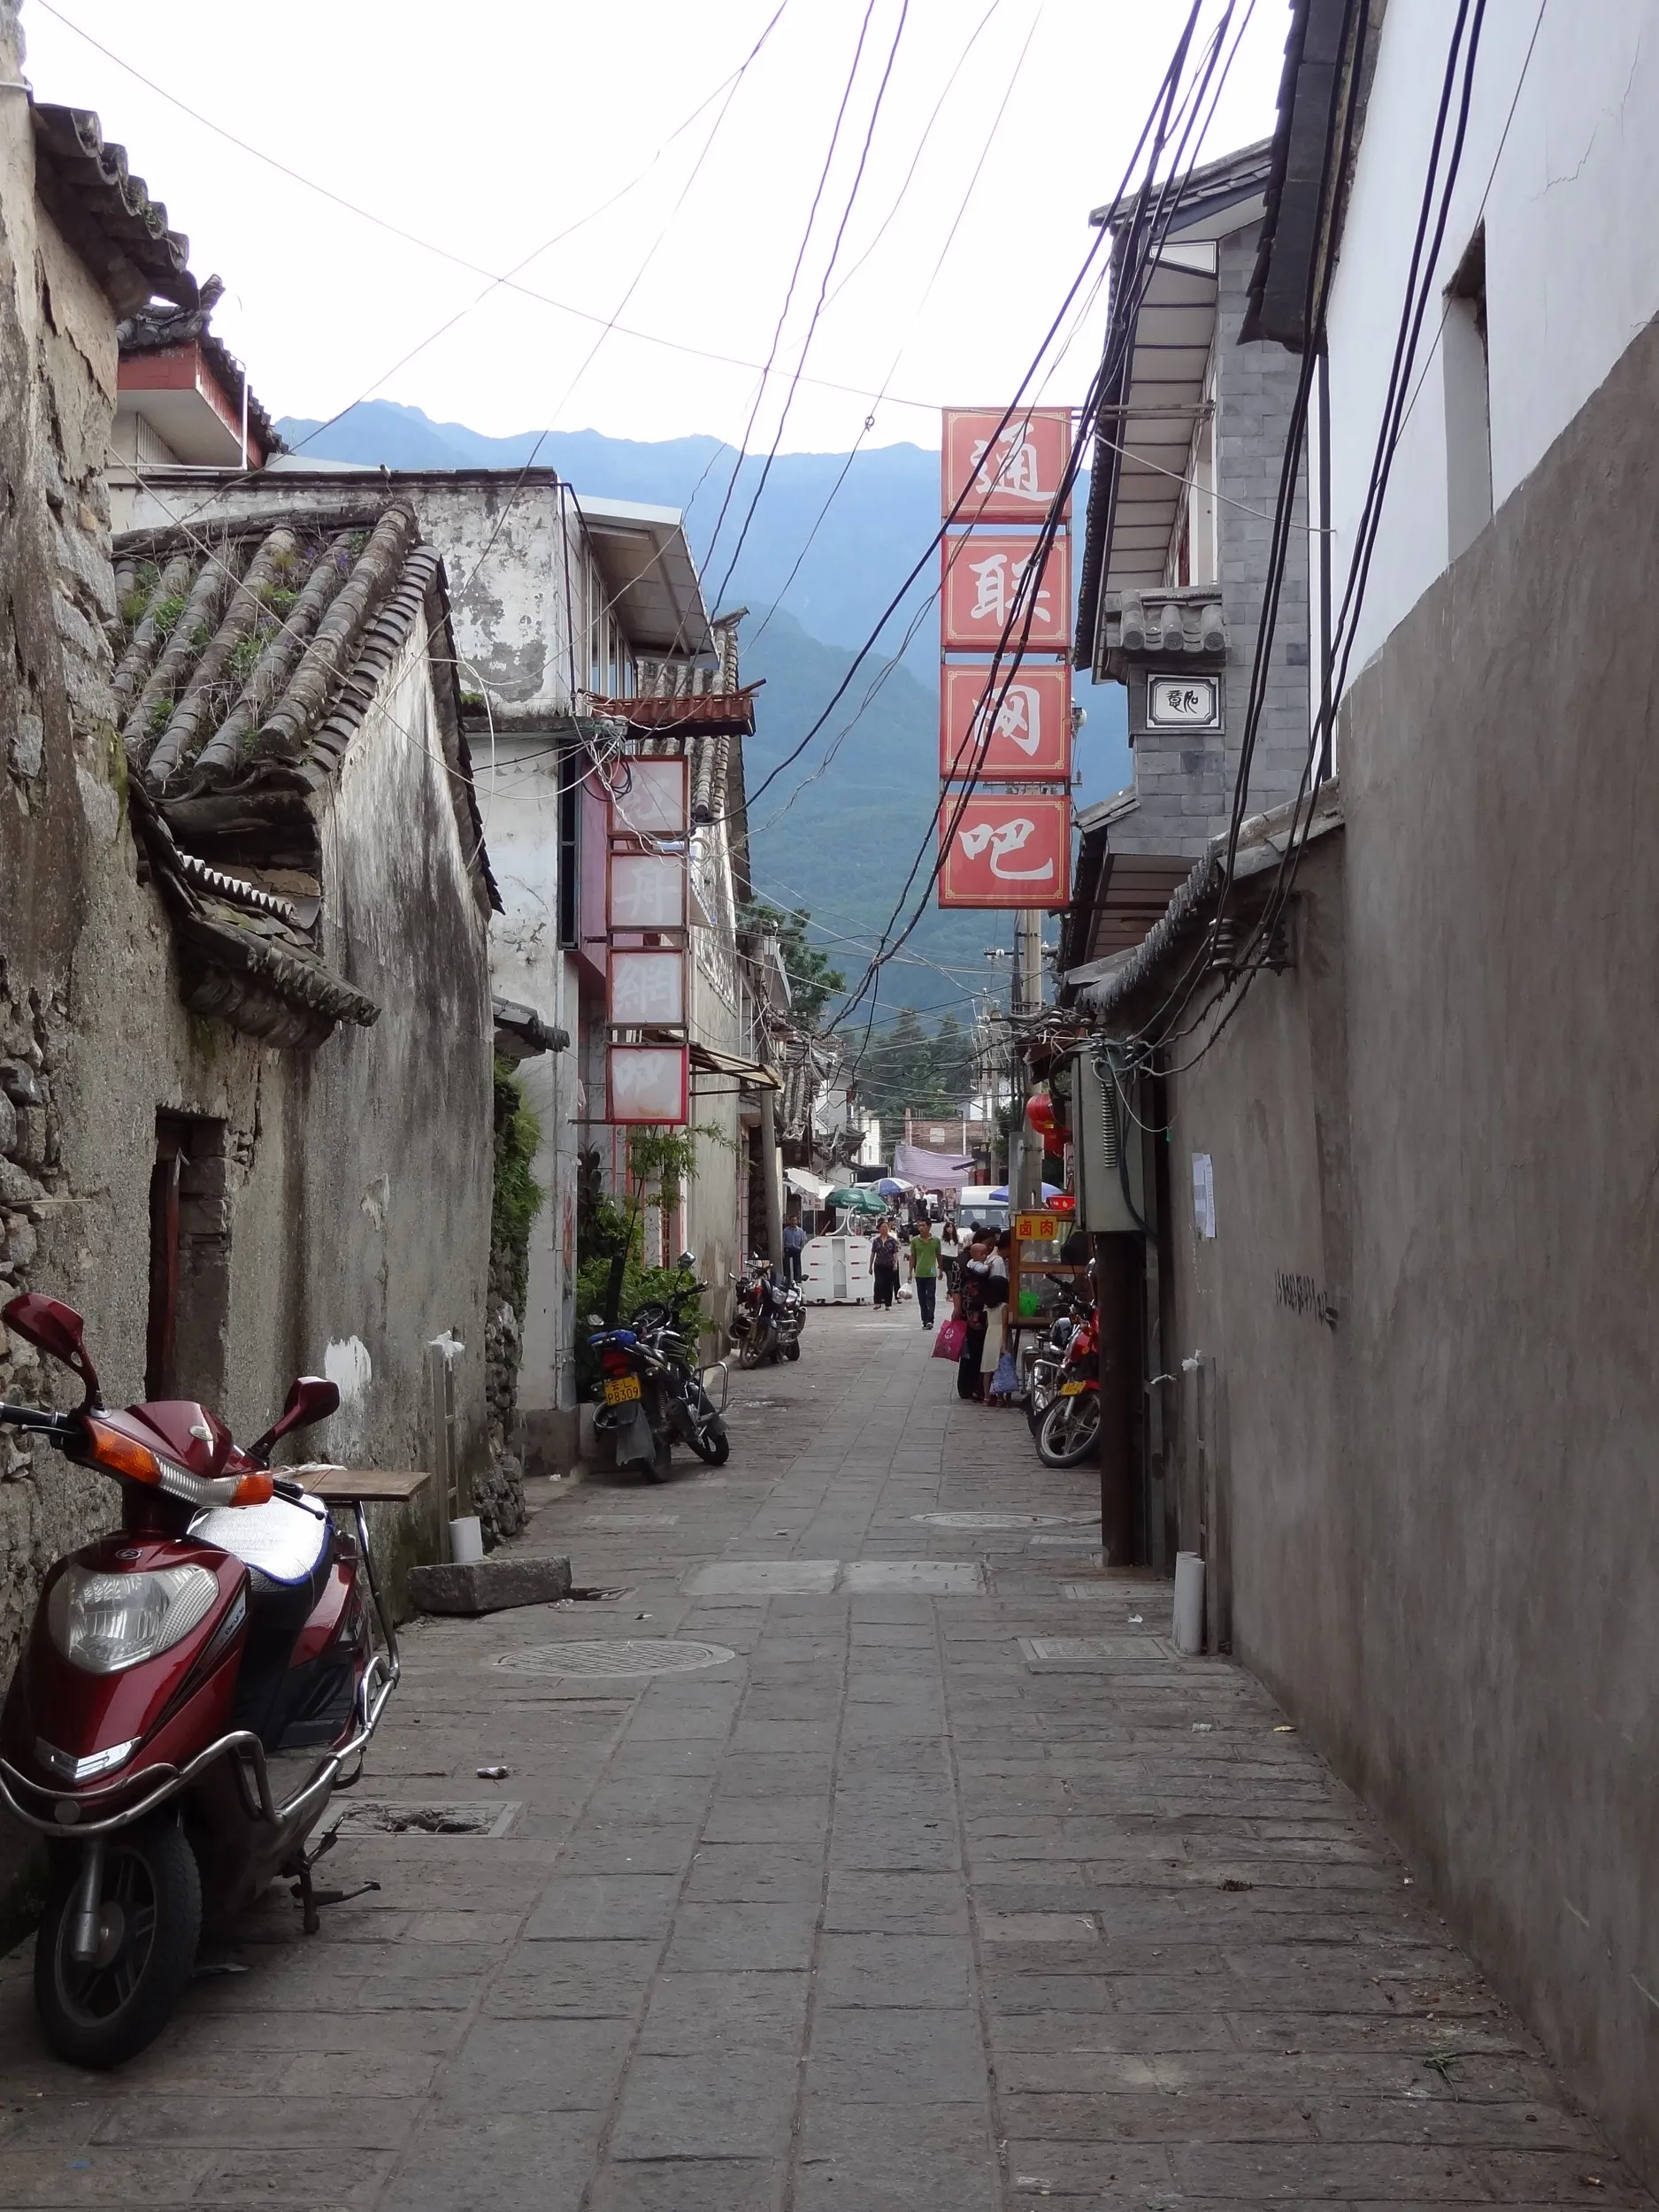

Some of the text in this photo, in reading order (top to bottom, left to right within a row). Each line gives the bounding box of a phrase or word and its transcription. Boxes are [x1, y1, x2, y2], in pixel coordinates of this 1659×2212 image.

[958, 420, 1056, 880] 通联网吧
[607, 1386, 639, 1404] P8309
